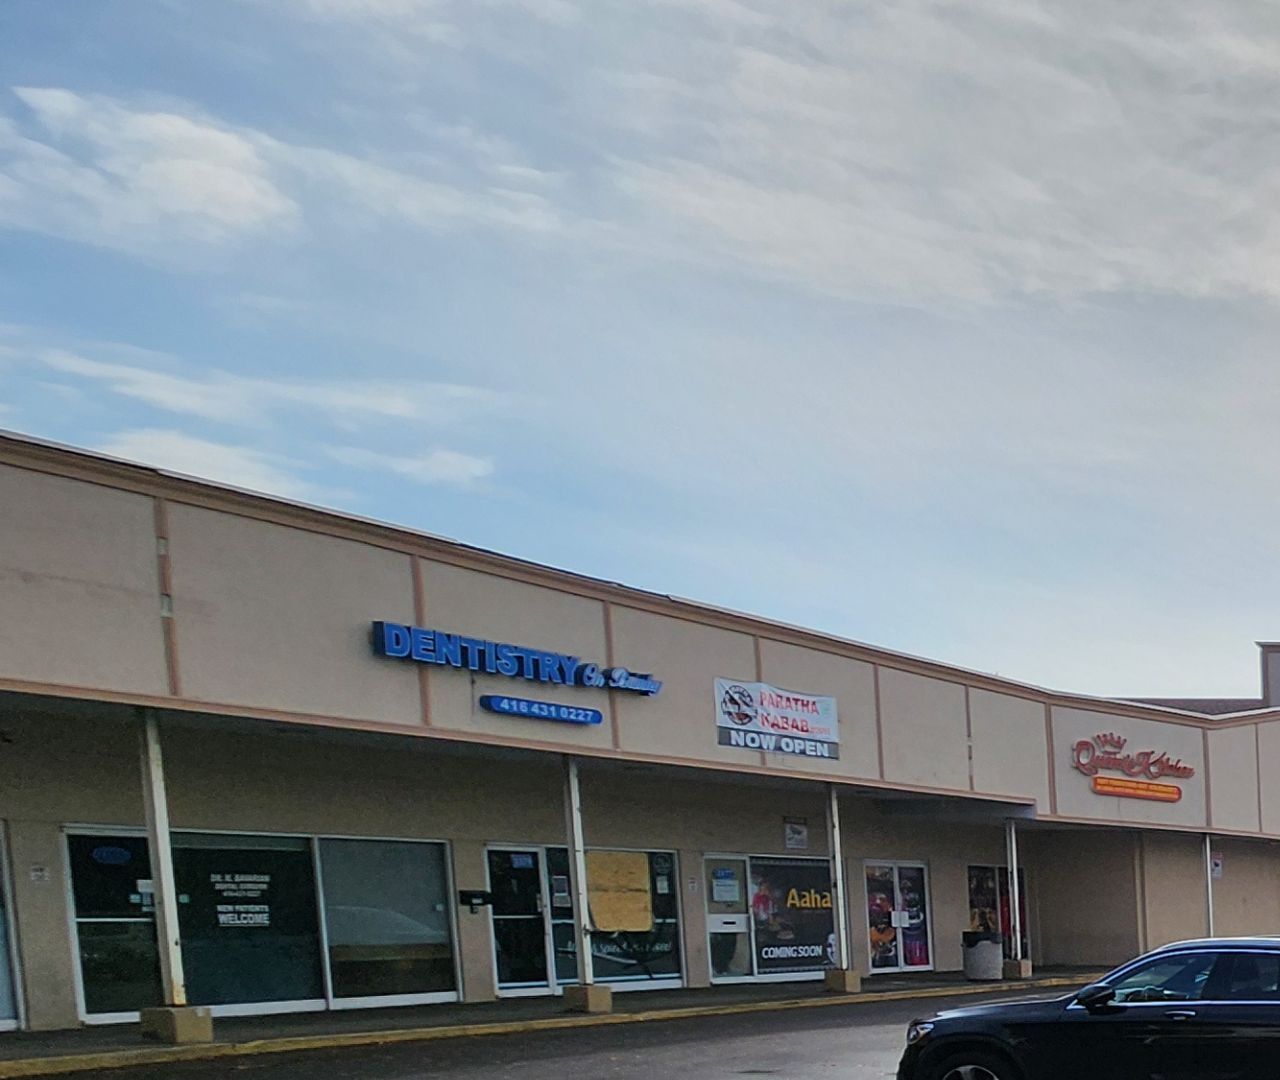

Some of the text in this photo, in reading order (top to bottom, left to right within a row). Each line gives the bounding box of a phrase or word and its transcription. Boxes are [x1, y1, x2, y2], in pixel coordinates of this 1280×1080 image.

[381, 622, 580, 687] DENTISTRY
[500, 698, 593, 721] 416 431 0227
[759, 691, 820, 715] PARATHA
[730, 731, 829, 756] NOW OPEN
[218, 913, 270, 924] WELCOME
[762, 946, 822, 958] COMING SOON
